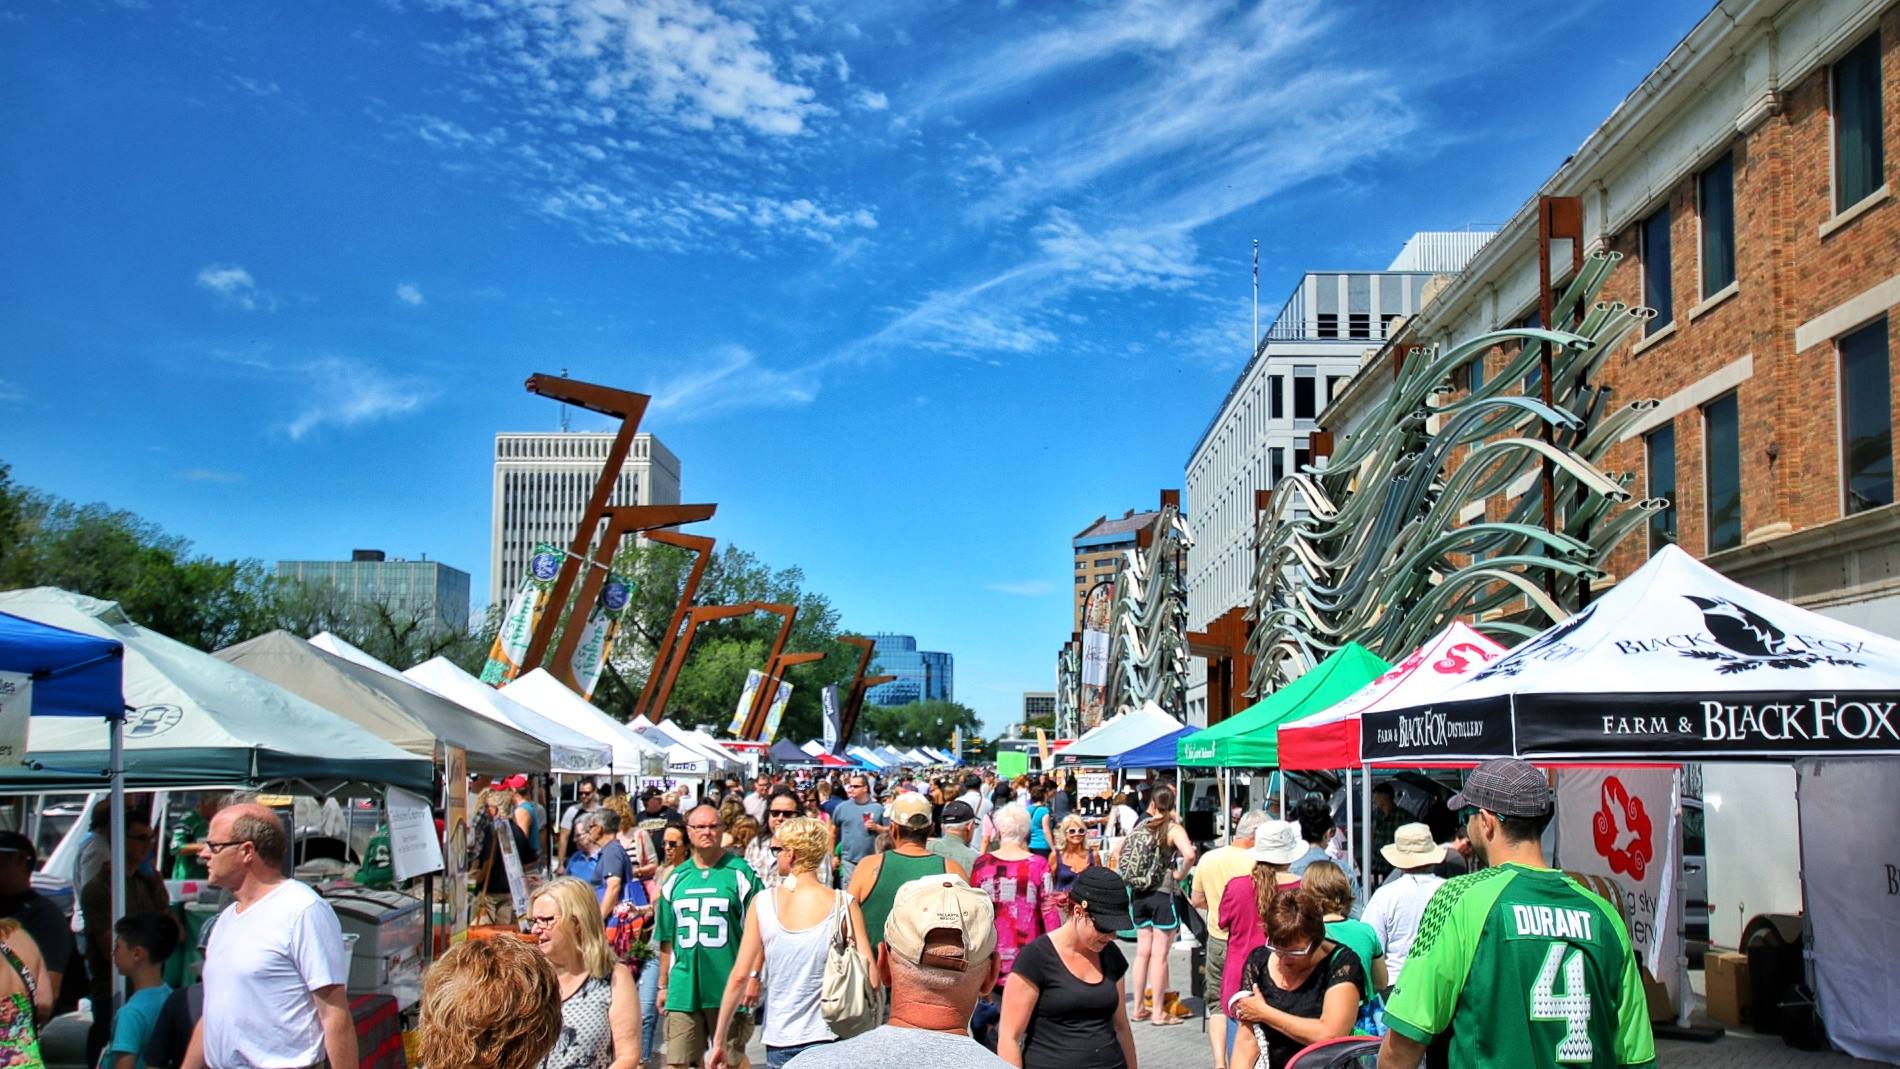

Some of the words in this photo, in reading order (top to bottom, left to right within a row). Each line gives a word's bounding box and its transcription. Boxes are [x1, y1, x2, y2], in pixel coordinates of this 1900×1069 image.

[1615, 632, 1716, 655] BLACK
[1447, 721, 1484, 738] DISTILLERY
[1602, 715, 1669, 735] FARM
[1678, 716, 1694, 734] &
[1639, 889, 1656, 920] sky
[673, 897, 730, 949] 55
[1512, 904, 1592, 940] DURANT
[1530, 941, 1593, 1063] 4
